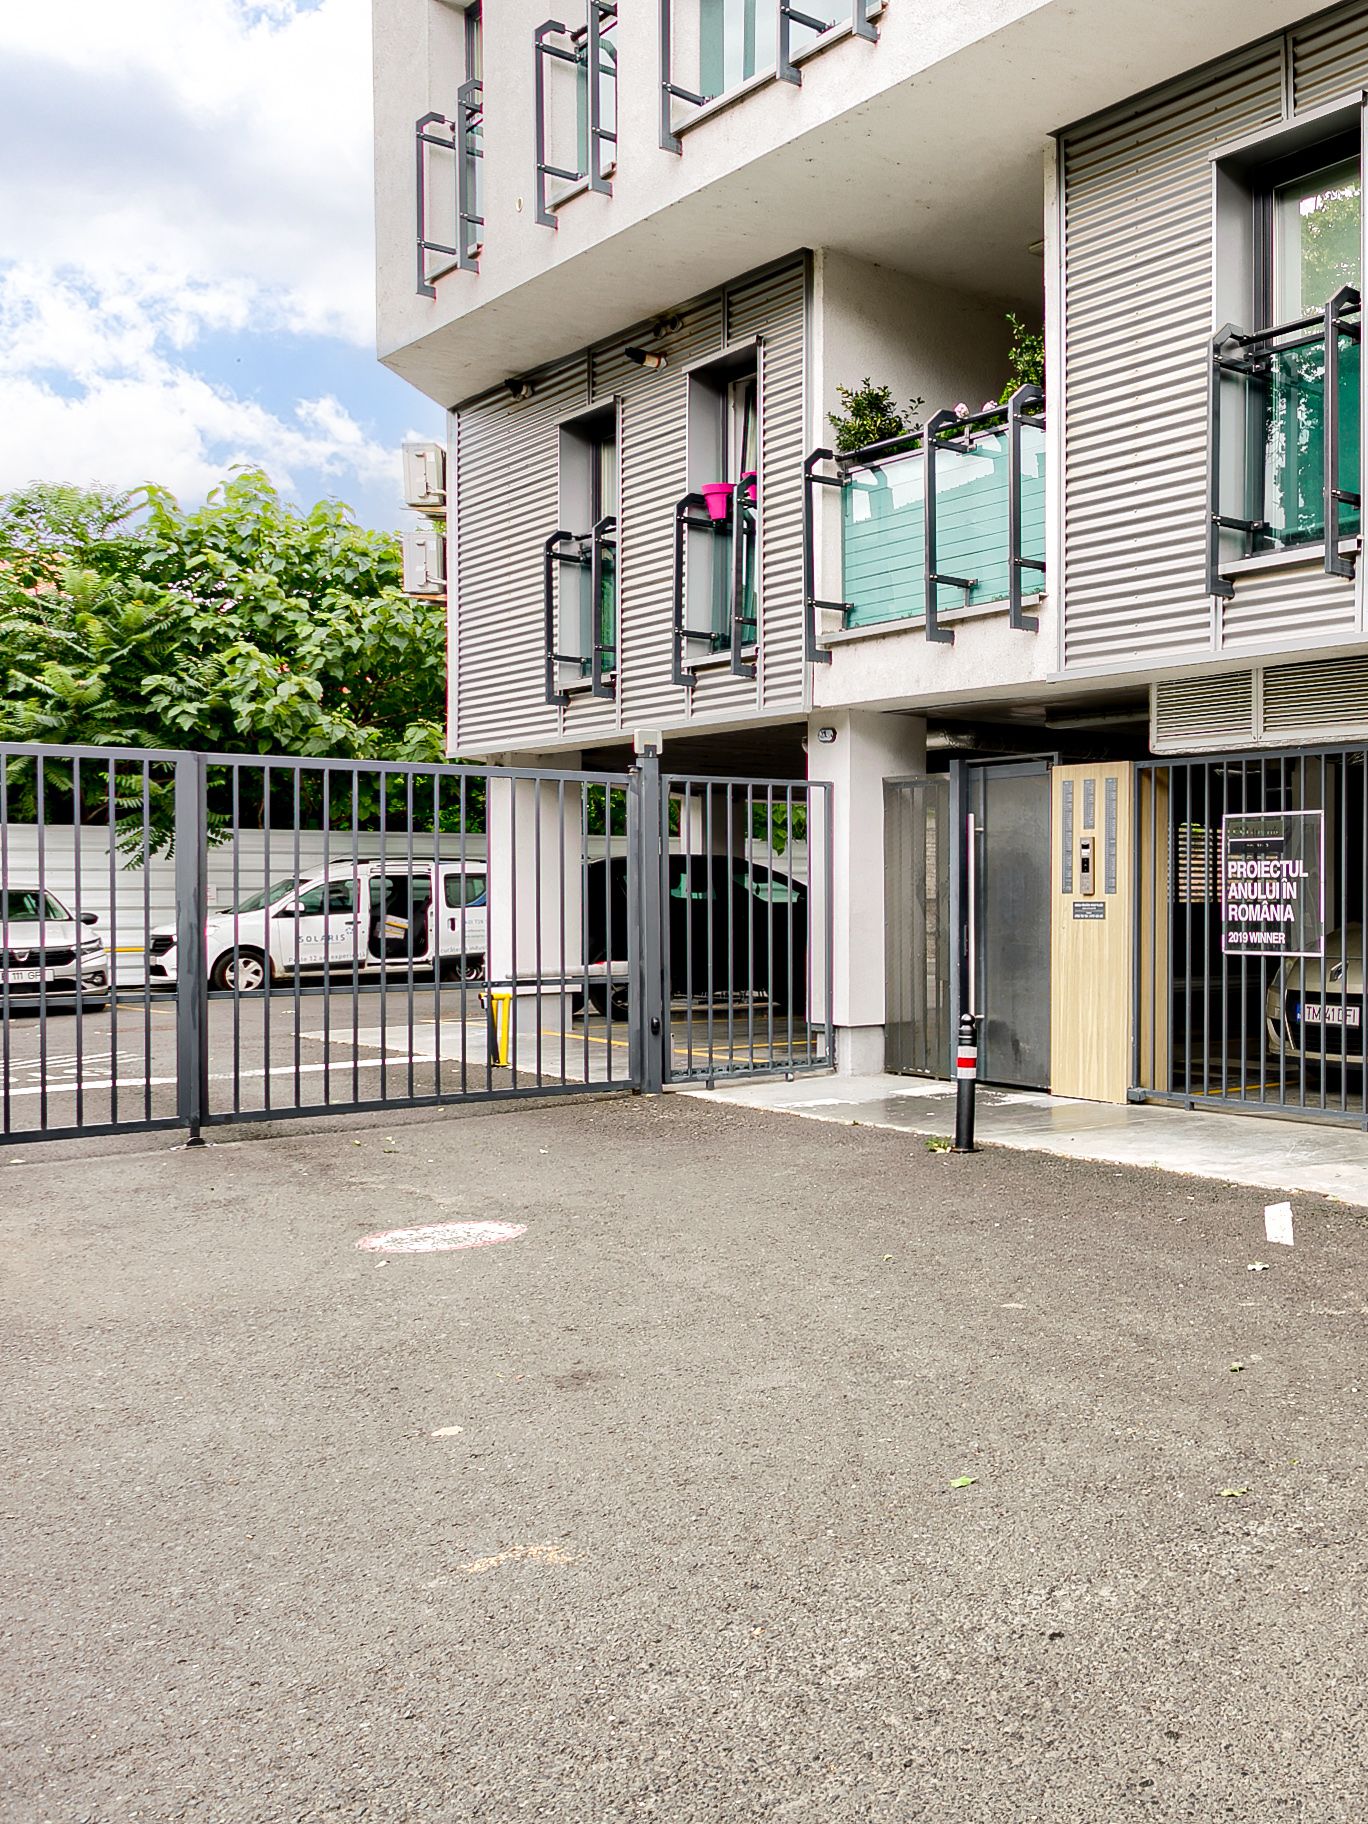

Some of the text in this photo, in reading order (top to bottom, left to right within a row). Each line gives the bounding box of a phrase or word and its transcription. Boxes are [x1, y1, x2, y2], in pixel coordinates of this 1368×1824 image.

[1228, 860, 1308, 878] PROIECTUL
[1228, 878, 1297, 899] ANULUI ÎN
[1228, 901, 1294, 922] ROMÂNIA
[1228, 932, 1285, 944] 2019 WINNER
[1307, 1006, 1321, 1020] TM
